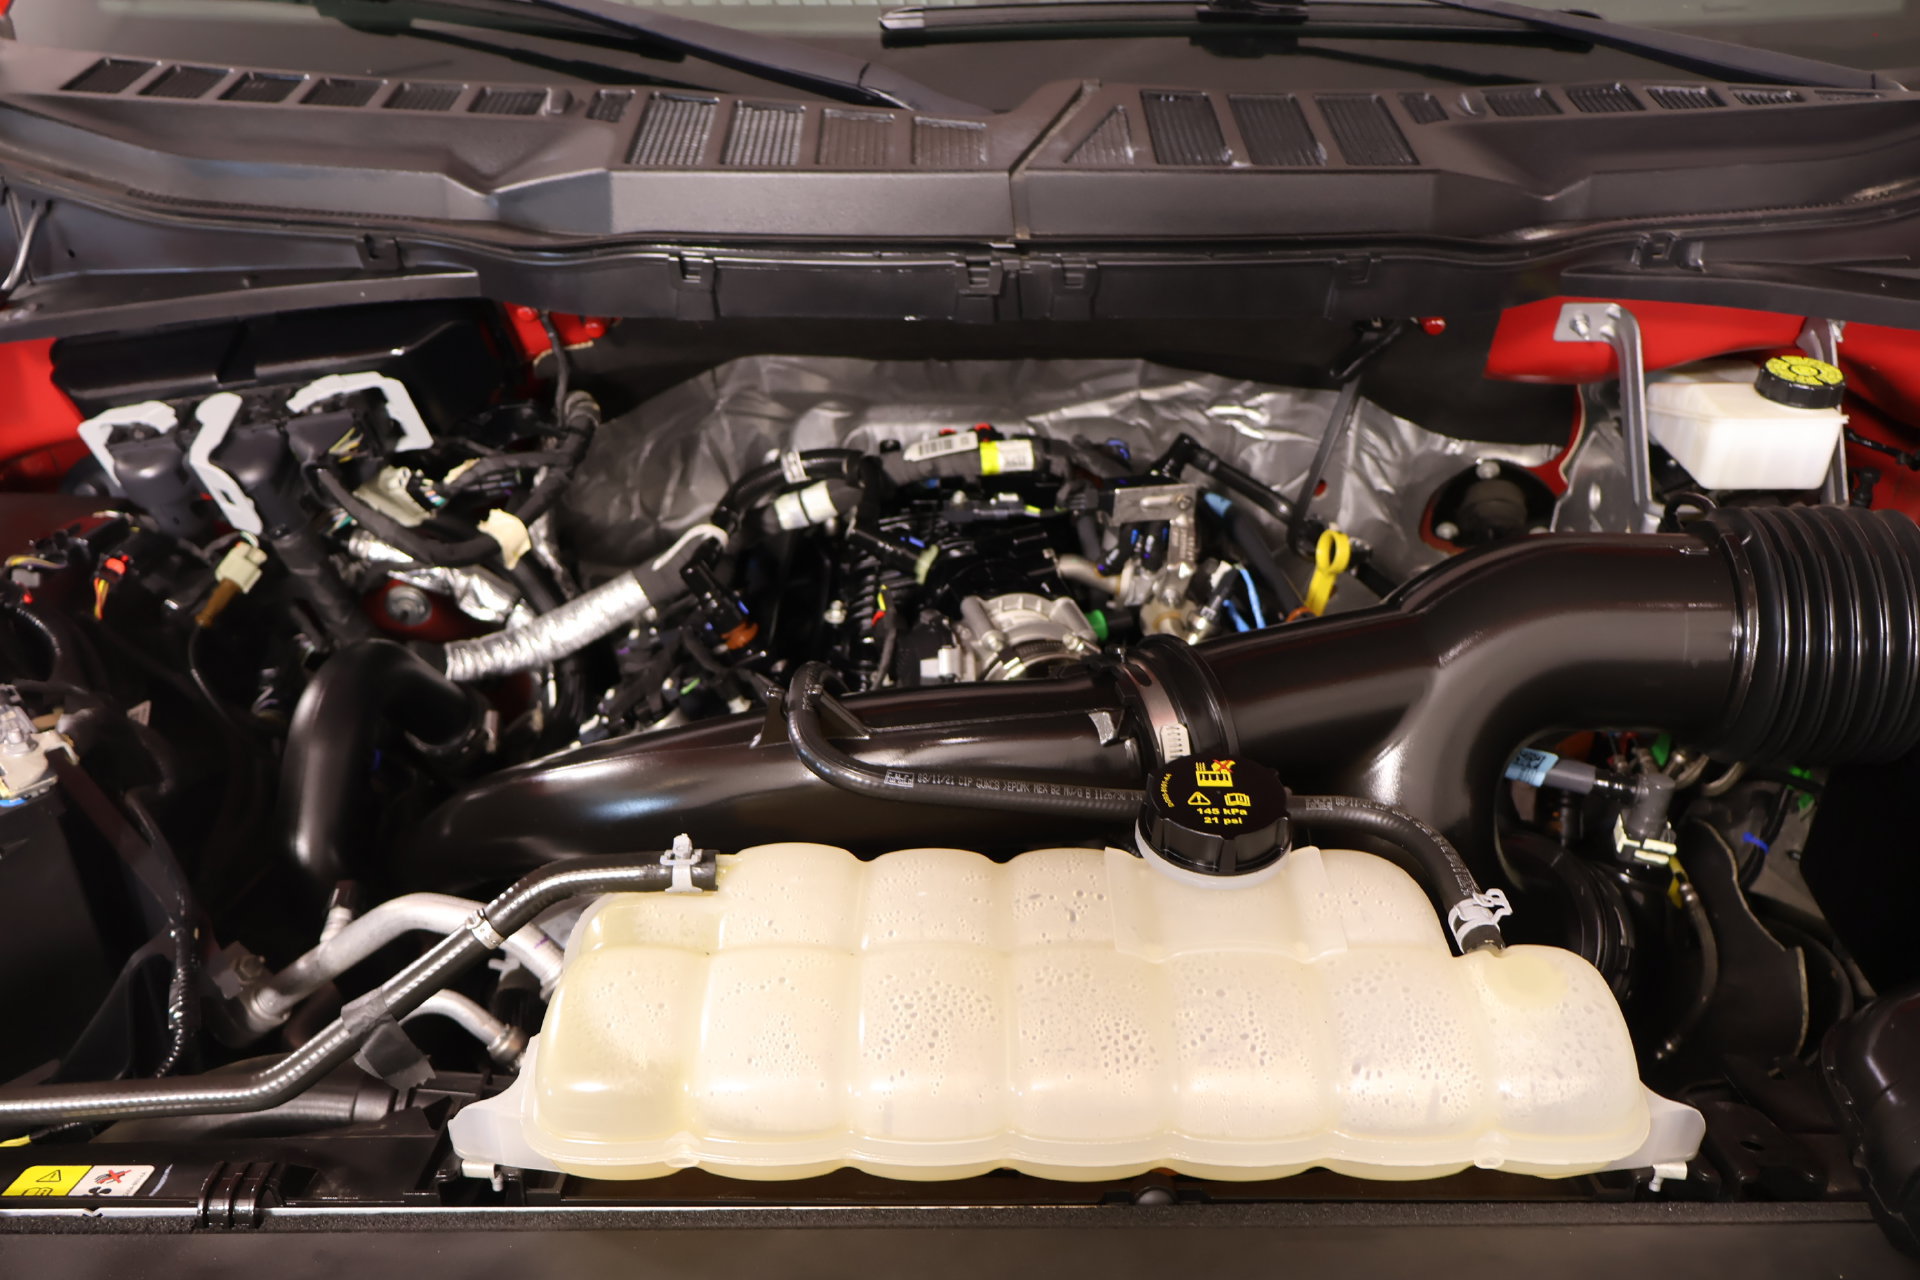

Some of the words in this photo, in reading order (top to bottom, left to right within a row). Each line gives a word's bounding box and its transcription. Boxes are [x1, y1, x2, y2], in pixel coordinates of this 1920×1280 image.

[1196, 807, 1220, 815] 145
[1222, 807, 1248, 815] kPa
[1203, 816, 1219, 824] 21
[1223, 816, 1243, 825] psi
